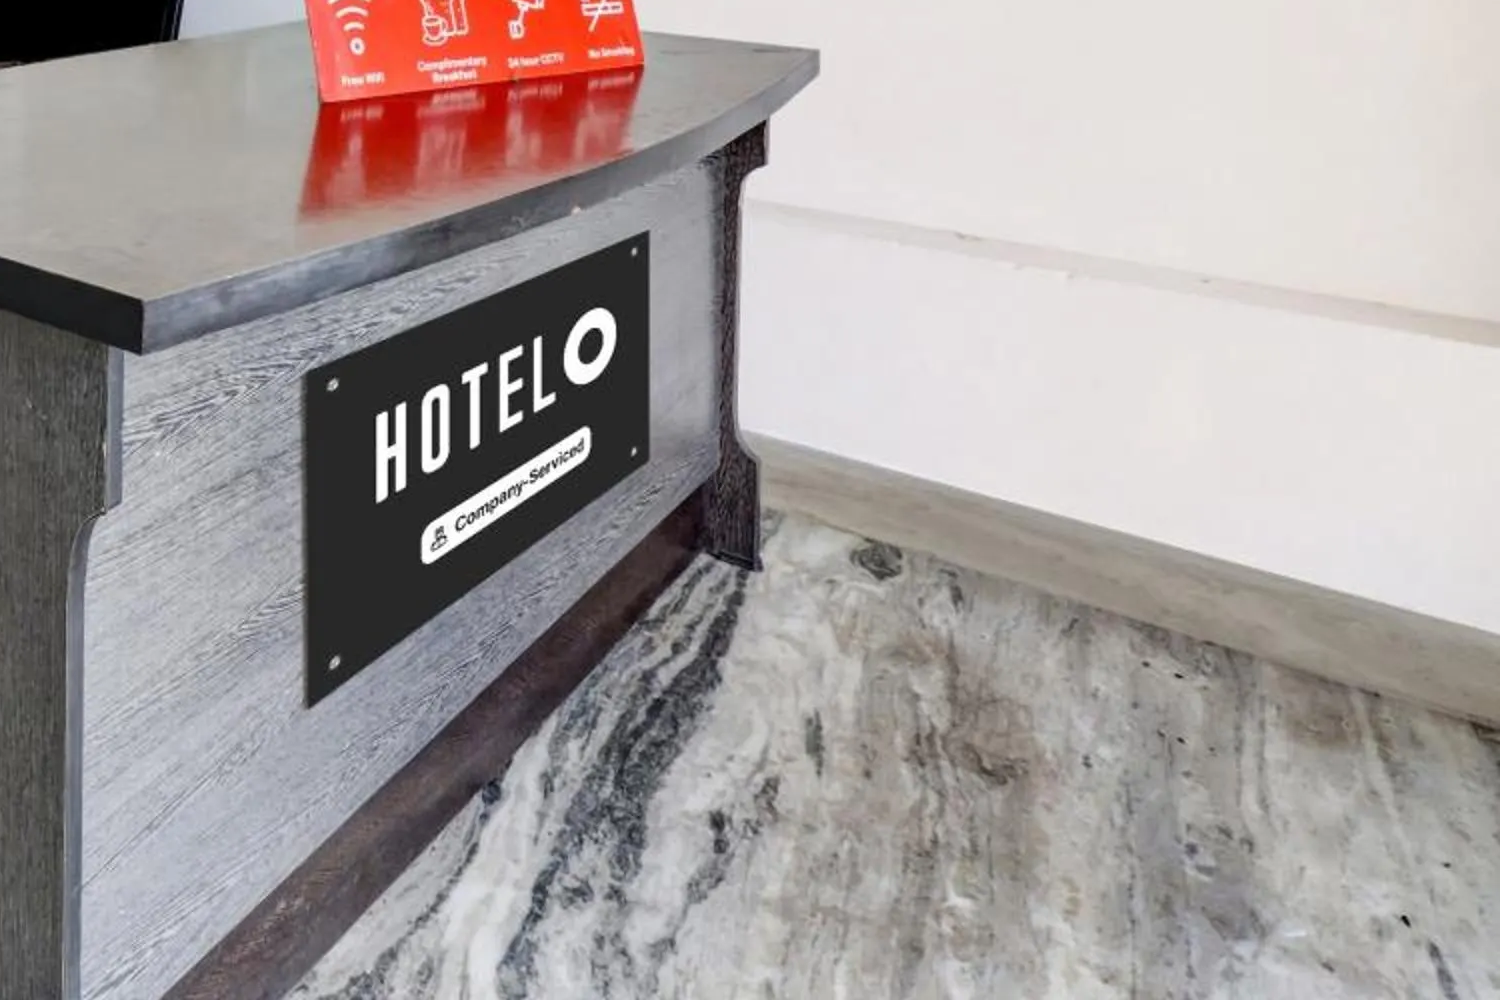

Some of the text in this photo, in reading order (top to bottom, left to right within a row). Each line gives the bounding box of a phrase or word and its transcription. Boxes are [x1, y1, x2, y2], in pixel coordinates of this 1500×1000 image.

[375, 306, 618, 504] HOTEL O
[454, 437, 586, 532] Company-Serviced
